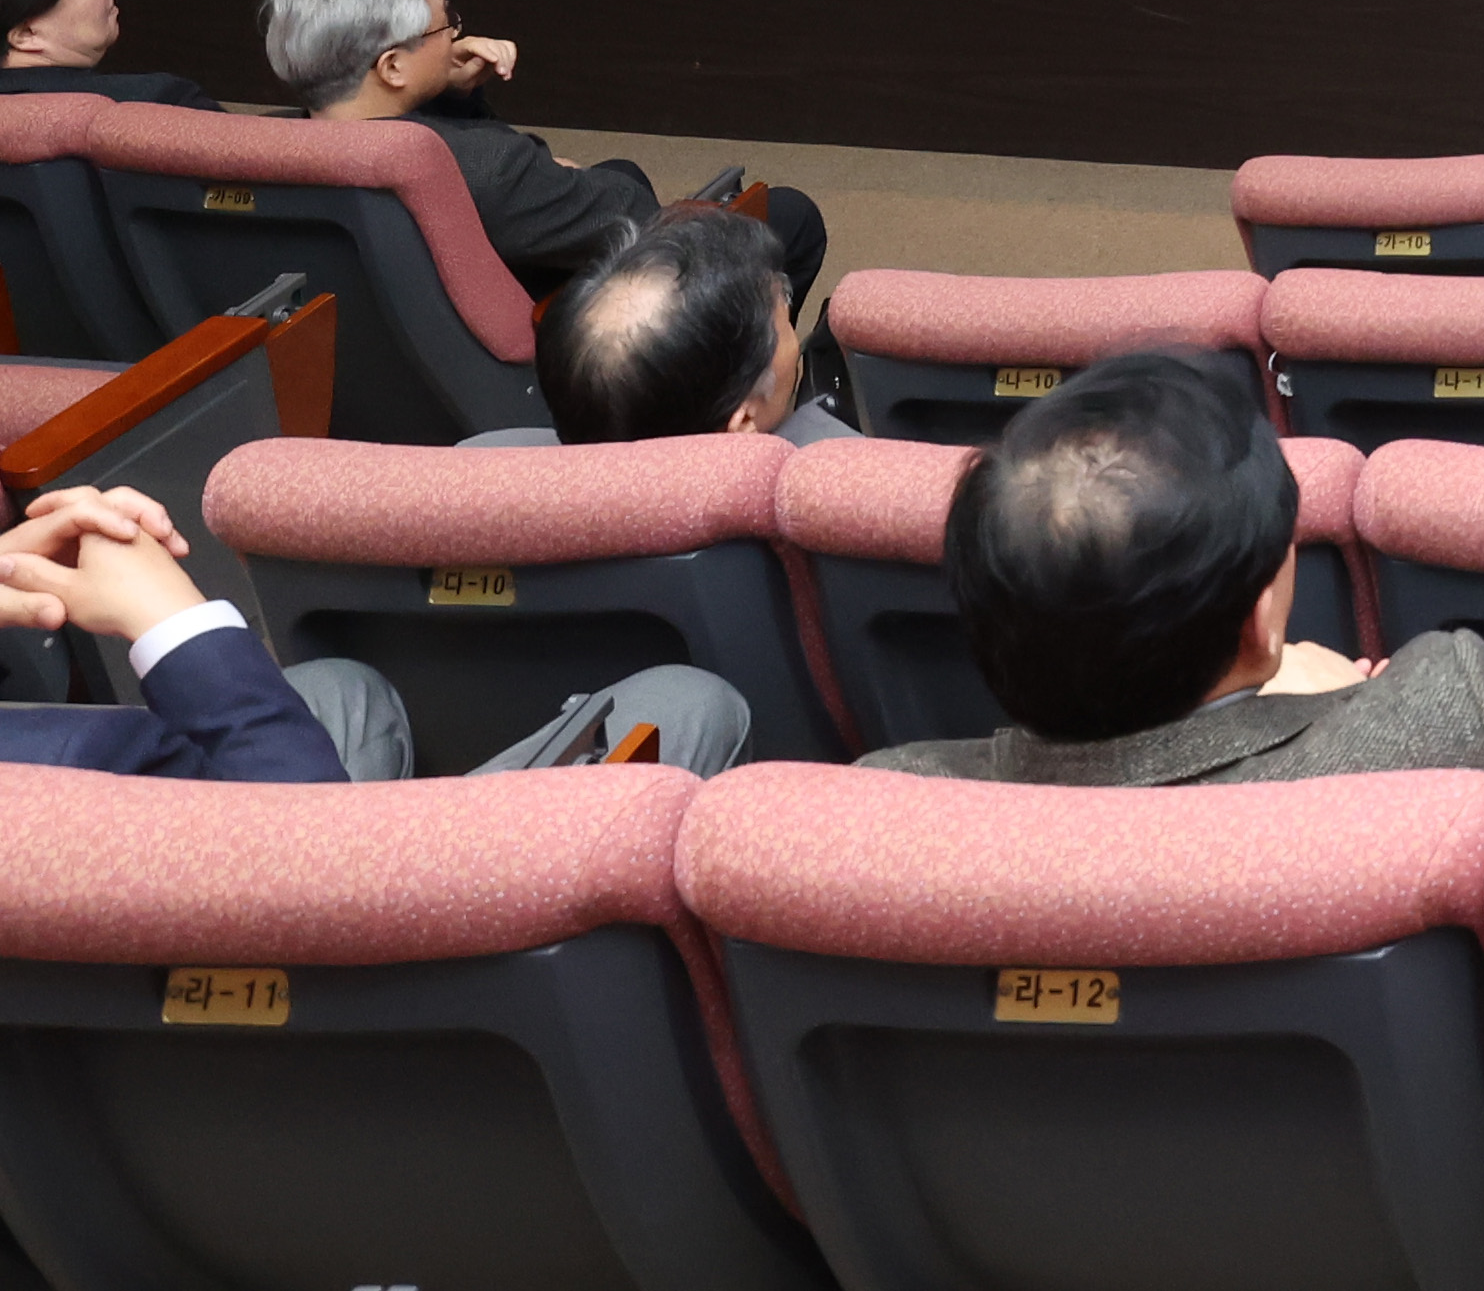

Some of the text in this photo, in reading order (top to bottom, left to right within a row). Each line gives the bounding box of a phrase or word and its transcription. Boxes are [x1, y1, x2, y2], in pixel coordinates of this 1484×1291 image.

[1384, 237, 1423, 249] 가-10
[1006, 372, 1054, 389] 나-10
[443, 572, 505, 596] 다-10
[184, 976, 279, 1009] 라-11
[1015, 975, 1105, 1008] 라-12
